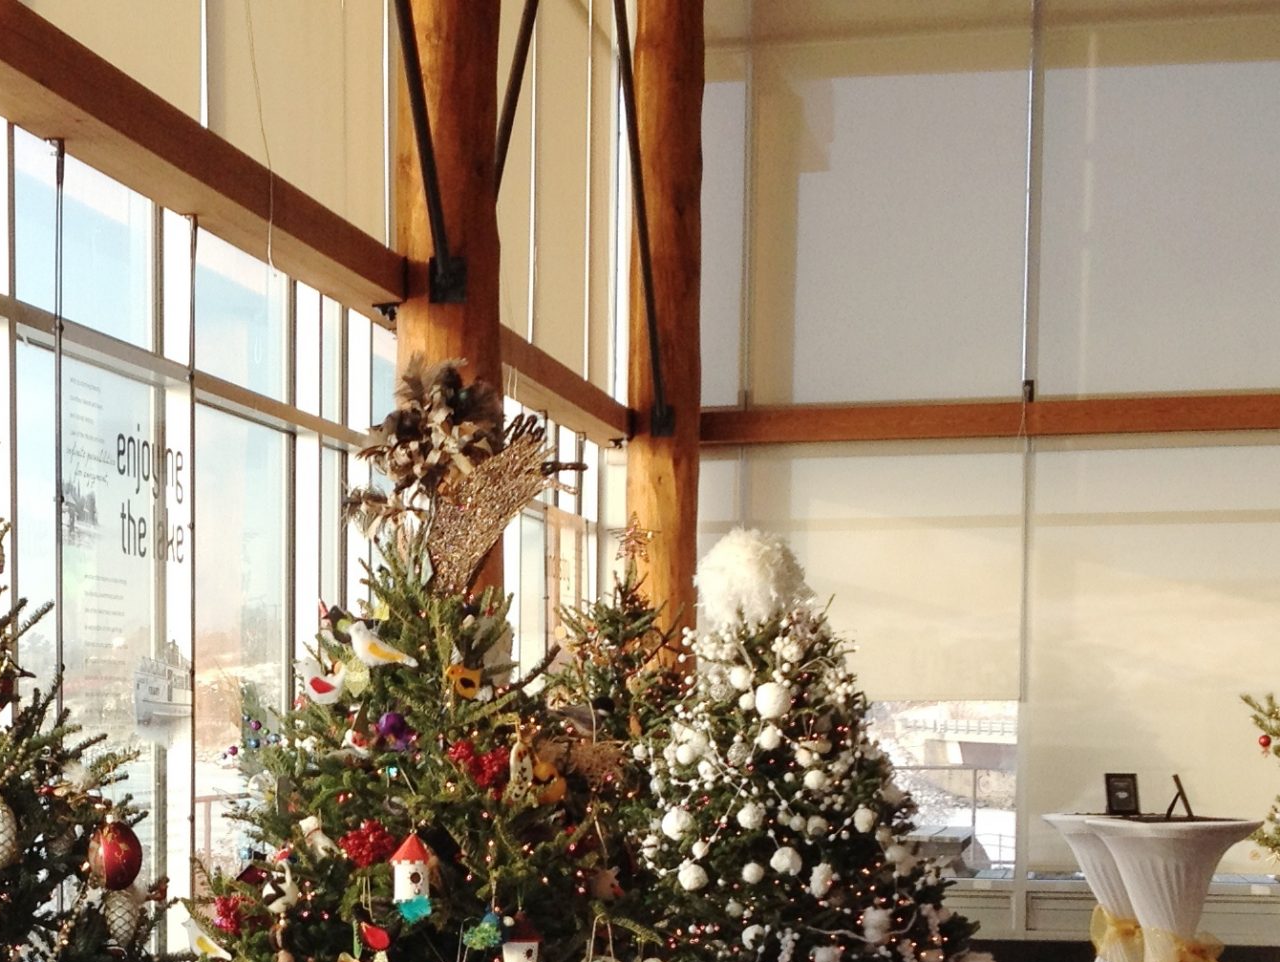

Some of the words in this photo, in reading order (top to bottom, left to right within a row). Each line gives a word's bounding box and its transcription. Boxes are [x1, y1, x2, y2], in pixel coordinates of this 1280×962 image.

[117, 423, 184, 504] enjoyng
[120, 499, 147, 558] the
[153, 504, 184, 563] lake
